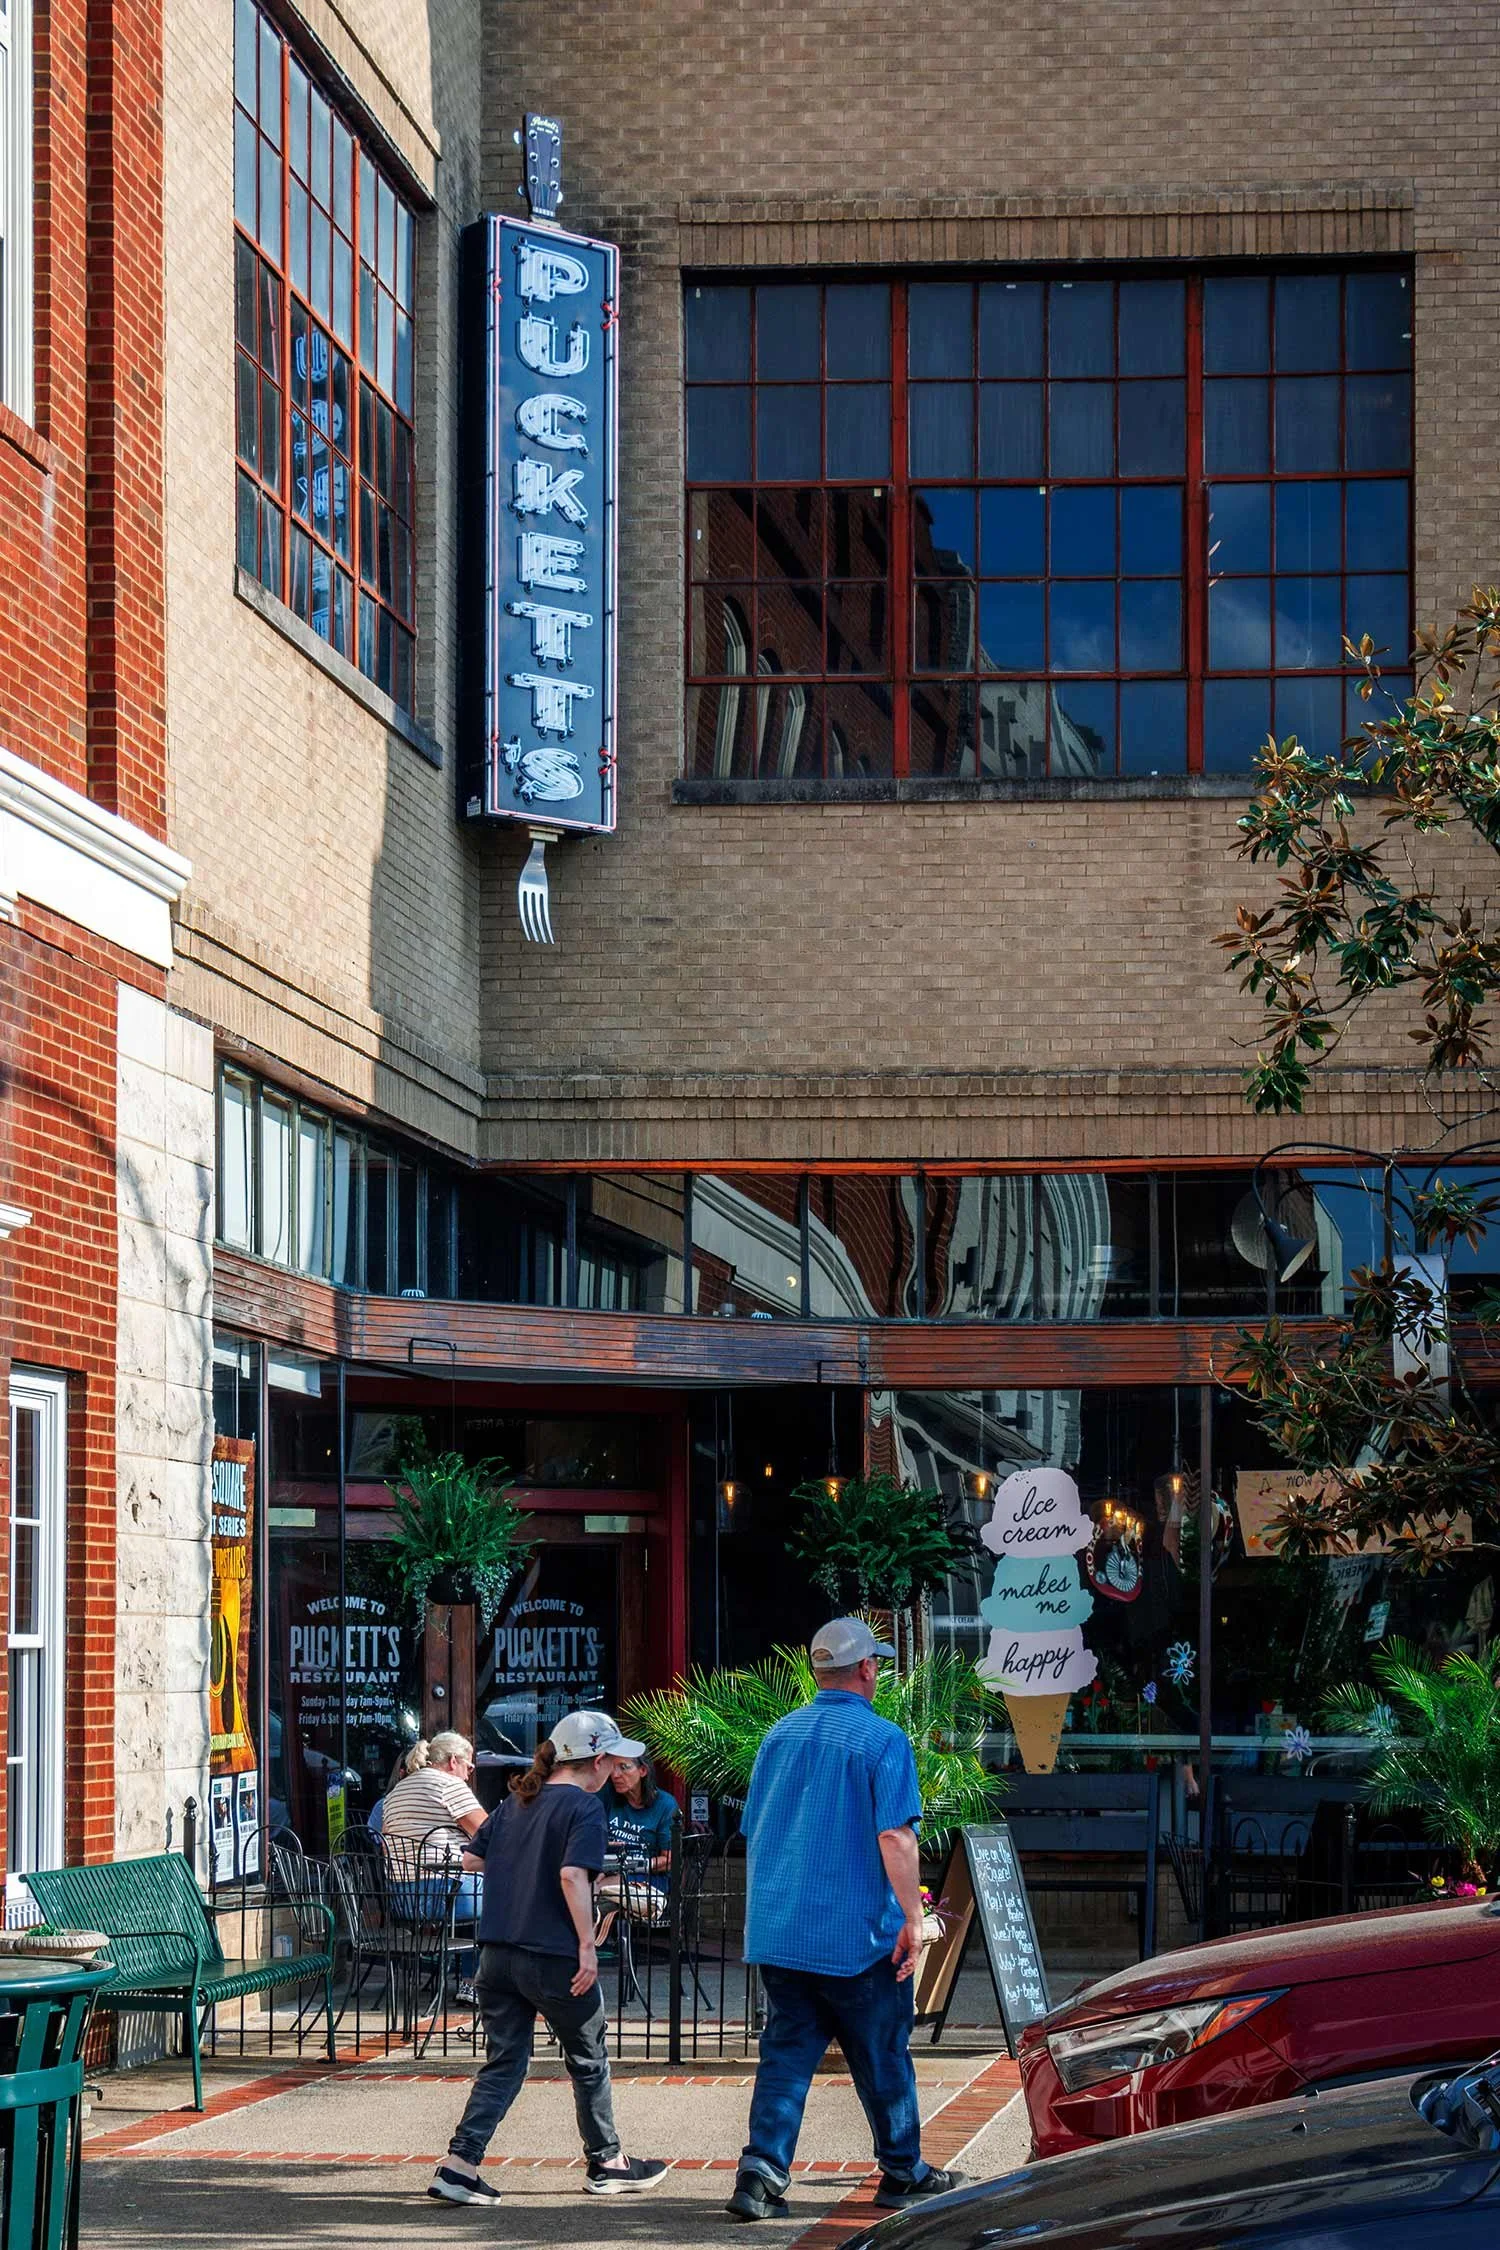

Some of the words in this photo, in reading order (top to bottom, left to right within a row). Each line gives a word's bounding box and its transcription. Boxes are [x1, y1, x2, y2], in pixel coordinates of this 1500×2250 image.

[502, 243, 595, 805] PUCKETT'S
[212, 1460, 247, 1513] SQUARE
[1013, 1486, 1057, 1522] Ice
[218, 1515, 247, 1538] SERIES
[1002, 1523, 1077, 1544] cream
[999, 1564, 1072, 1600] makes
[370, 1600, 386, 1616] TO
[510, 1599, 566, 1617] WELCOME
[570, 1602, 584, 1616] TO
[1035, 1599, 1071, 1614] me
[495, 1627, 599, 1668] PUCKETT'S
[1002, 1641, 1075, 1683] happy
[495, 1670, 598, 1684] RESTAURANT
[299, 1712, 320, 1726] Friday
[321, 1713, 327, 1724] &
[609, 1816, 619, 1828] A
[623, 1820, 645, 1833] DAY
[972, 1843, 991, 1861] Live
[990, 1848, 999, 1862] on
[998, 1841, 1012, 1864] the
